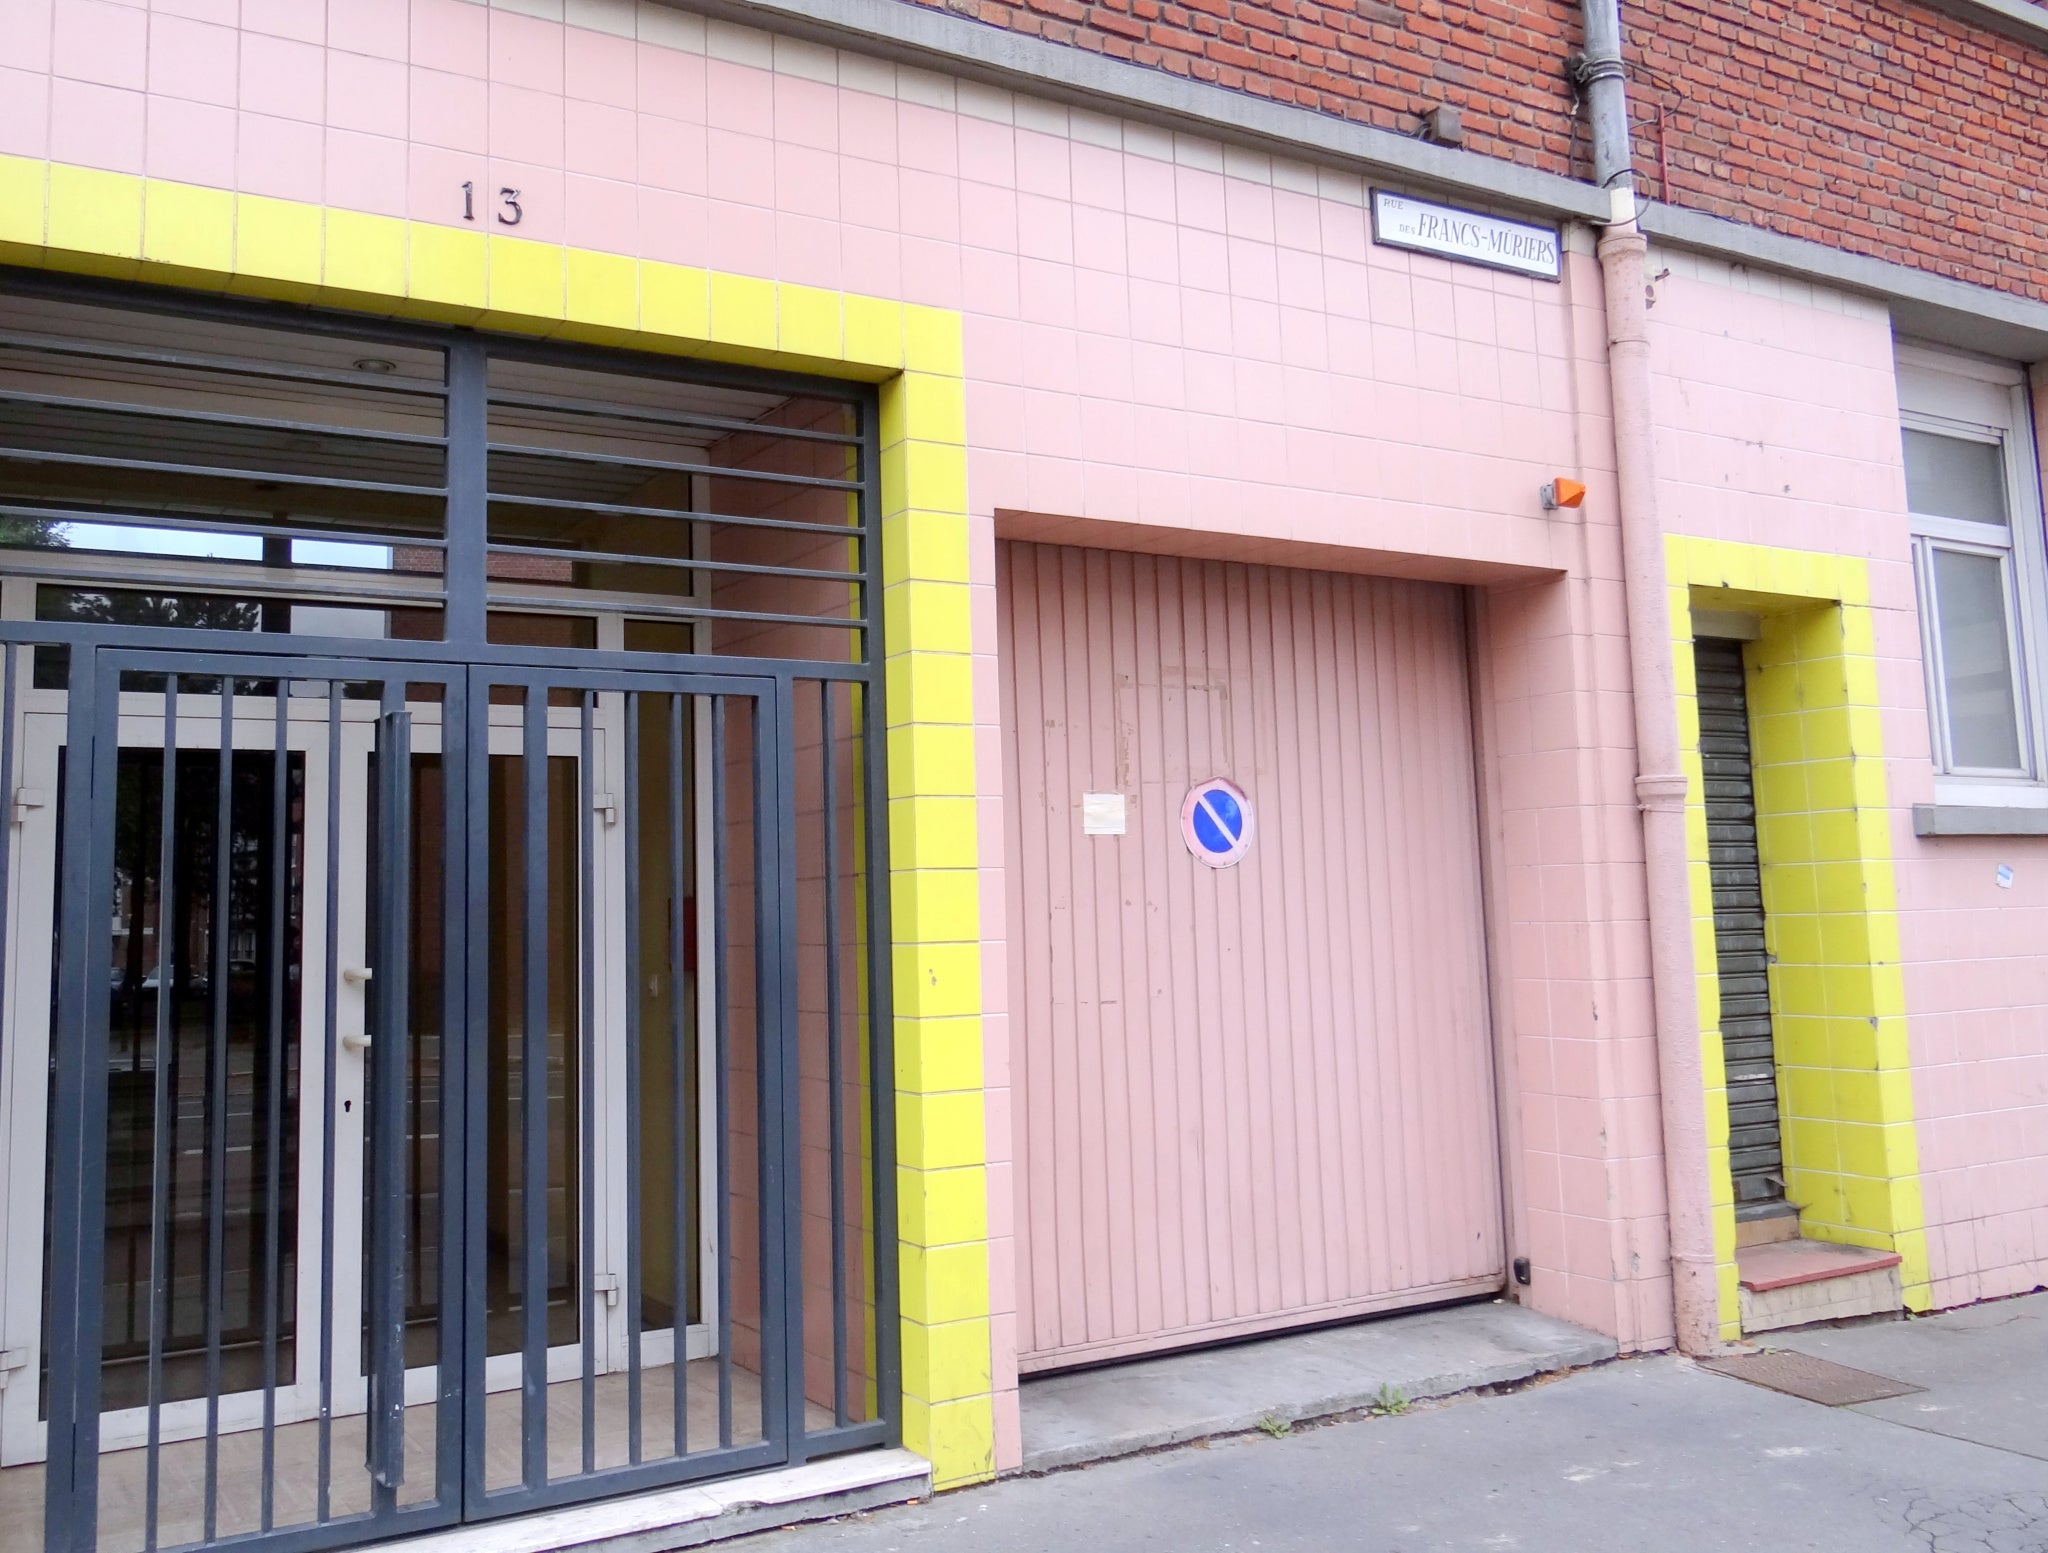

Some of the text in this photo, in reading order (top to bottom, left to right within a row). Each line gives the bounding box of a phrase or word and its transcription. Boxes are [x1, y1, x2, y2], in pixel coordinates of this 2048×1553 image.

[462, 181, 523, 226] 13
[1383, 198, 1404, 210] RUE
[1399, 223, 1416, 235] DES
